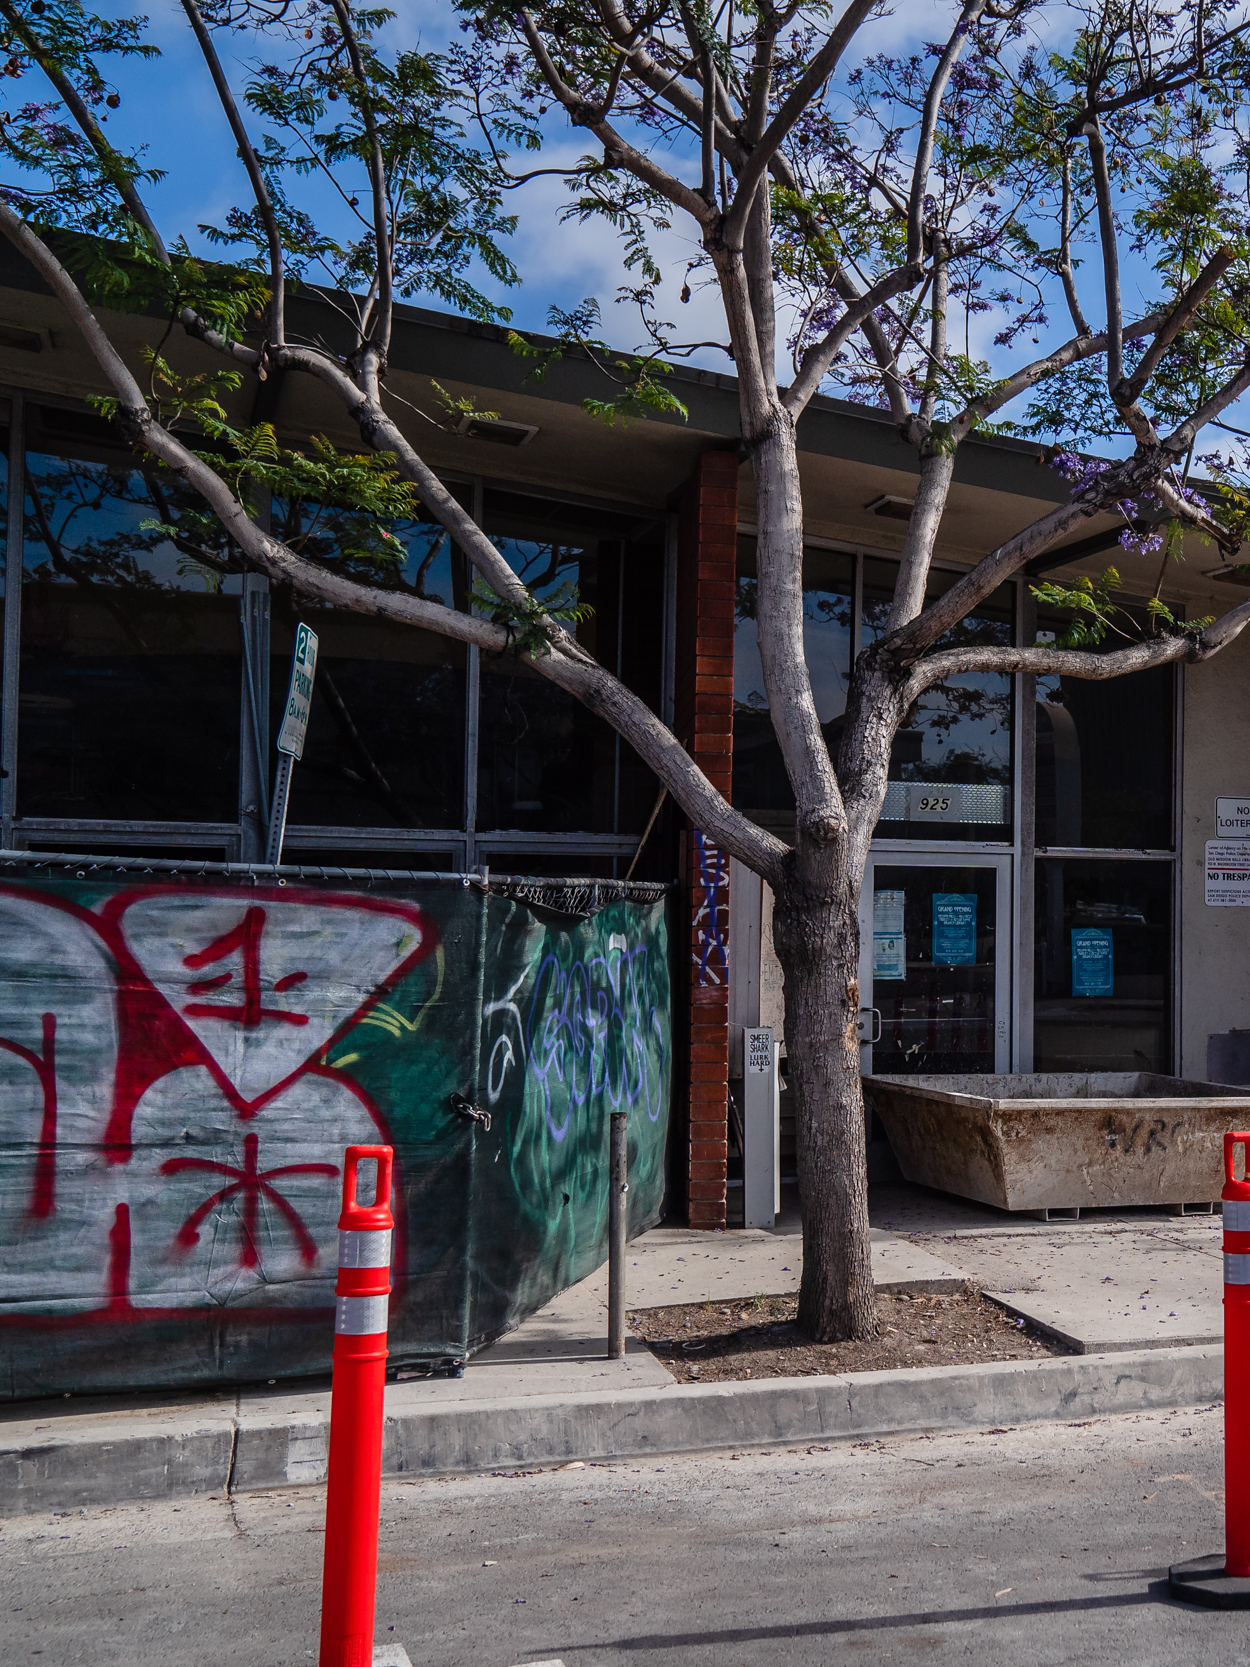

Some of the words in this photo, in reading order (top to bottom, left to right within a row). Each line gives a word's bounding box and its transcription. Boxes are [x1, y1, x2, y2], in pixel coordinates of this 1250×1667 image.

[298, 631, 306, 659] 2
[919, 797, 950, 811] 925
[1236, 806, 1250, 815] NO
[1207, 872, 1219, 881] NO
[750, 1044, 769, 1053] SHARK
